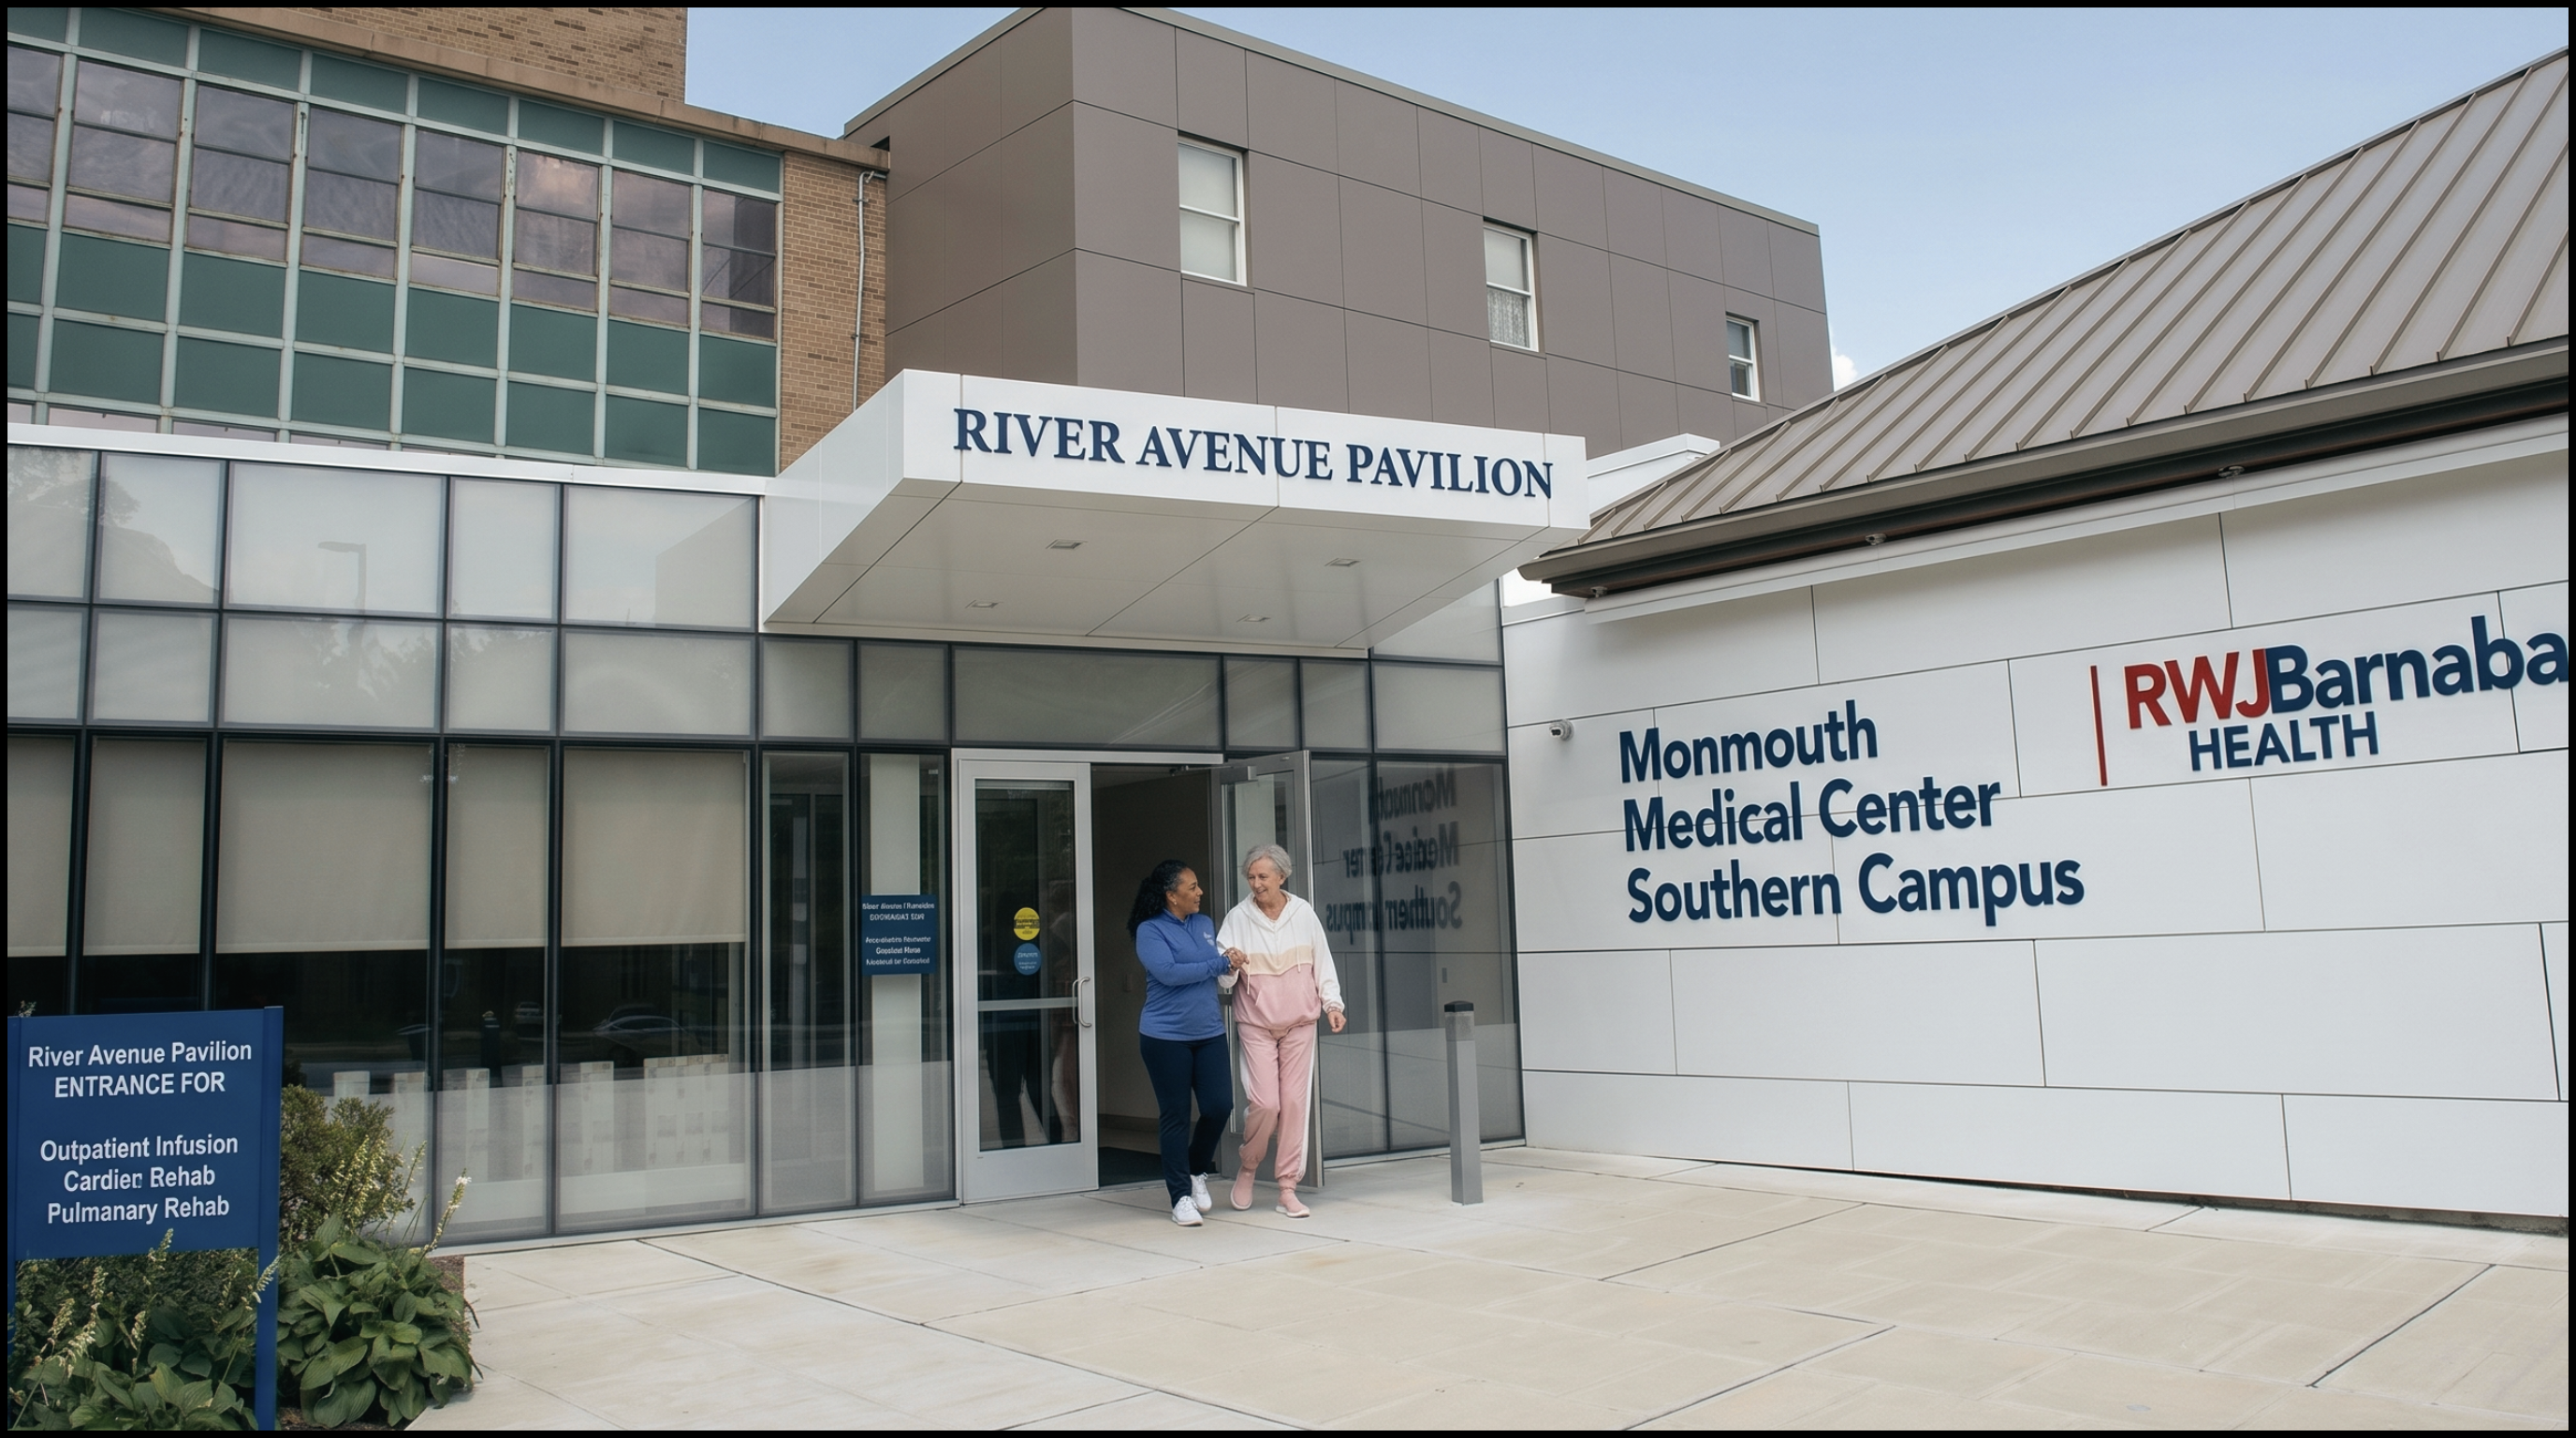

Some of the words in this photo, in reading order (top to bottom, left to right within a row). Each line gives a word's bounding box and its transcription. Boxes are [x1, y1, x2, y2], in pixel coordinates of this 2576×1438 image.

[954, 408, 1126, 464] RIVER
[1135, 425, 1334, 482] AVENUE
[1346, 444, 1554, 500] PAVILION
[1618, 698, 1879, 785] Monmouth
[2188, 711, 2379, 772] HEALTH
[1622, 780, 1804, 853] Medical
[1818, 776, 2001, 839] Center
[1628, 858, 1842, 923] Southern
[1858, 852, 2086, 928] Campus
[28, 1046, 84, 1067] River
[88, 1044, 166, 1065] Avenue
[171, 1040, 253, 1063] Pavilion
[54, 1073, 176, 1098] ENTRANCE
[181, 1071, 226, 1093] FOR
[40, 1137, 150, 1166] Outpatient
[156, 1134, 239, 1156] Infusion
[150, 1164, 215, 1188] Rehab
[48, 1200, 157, 1225] Pulmanary
[165, 1195, 230, 1219] Rehab
